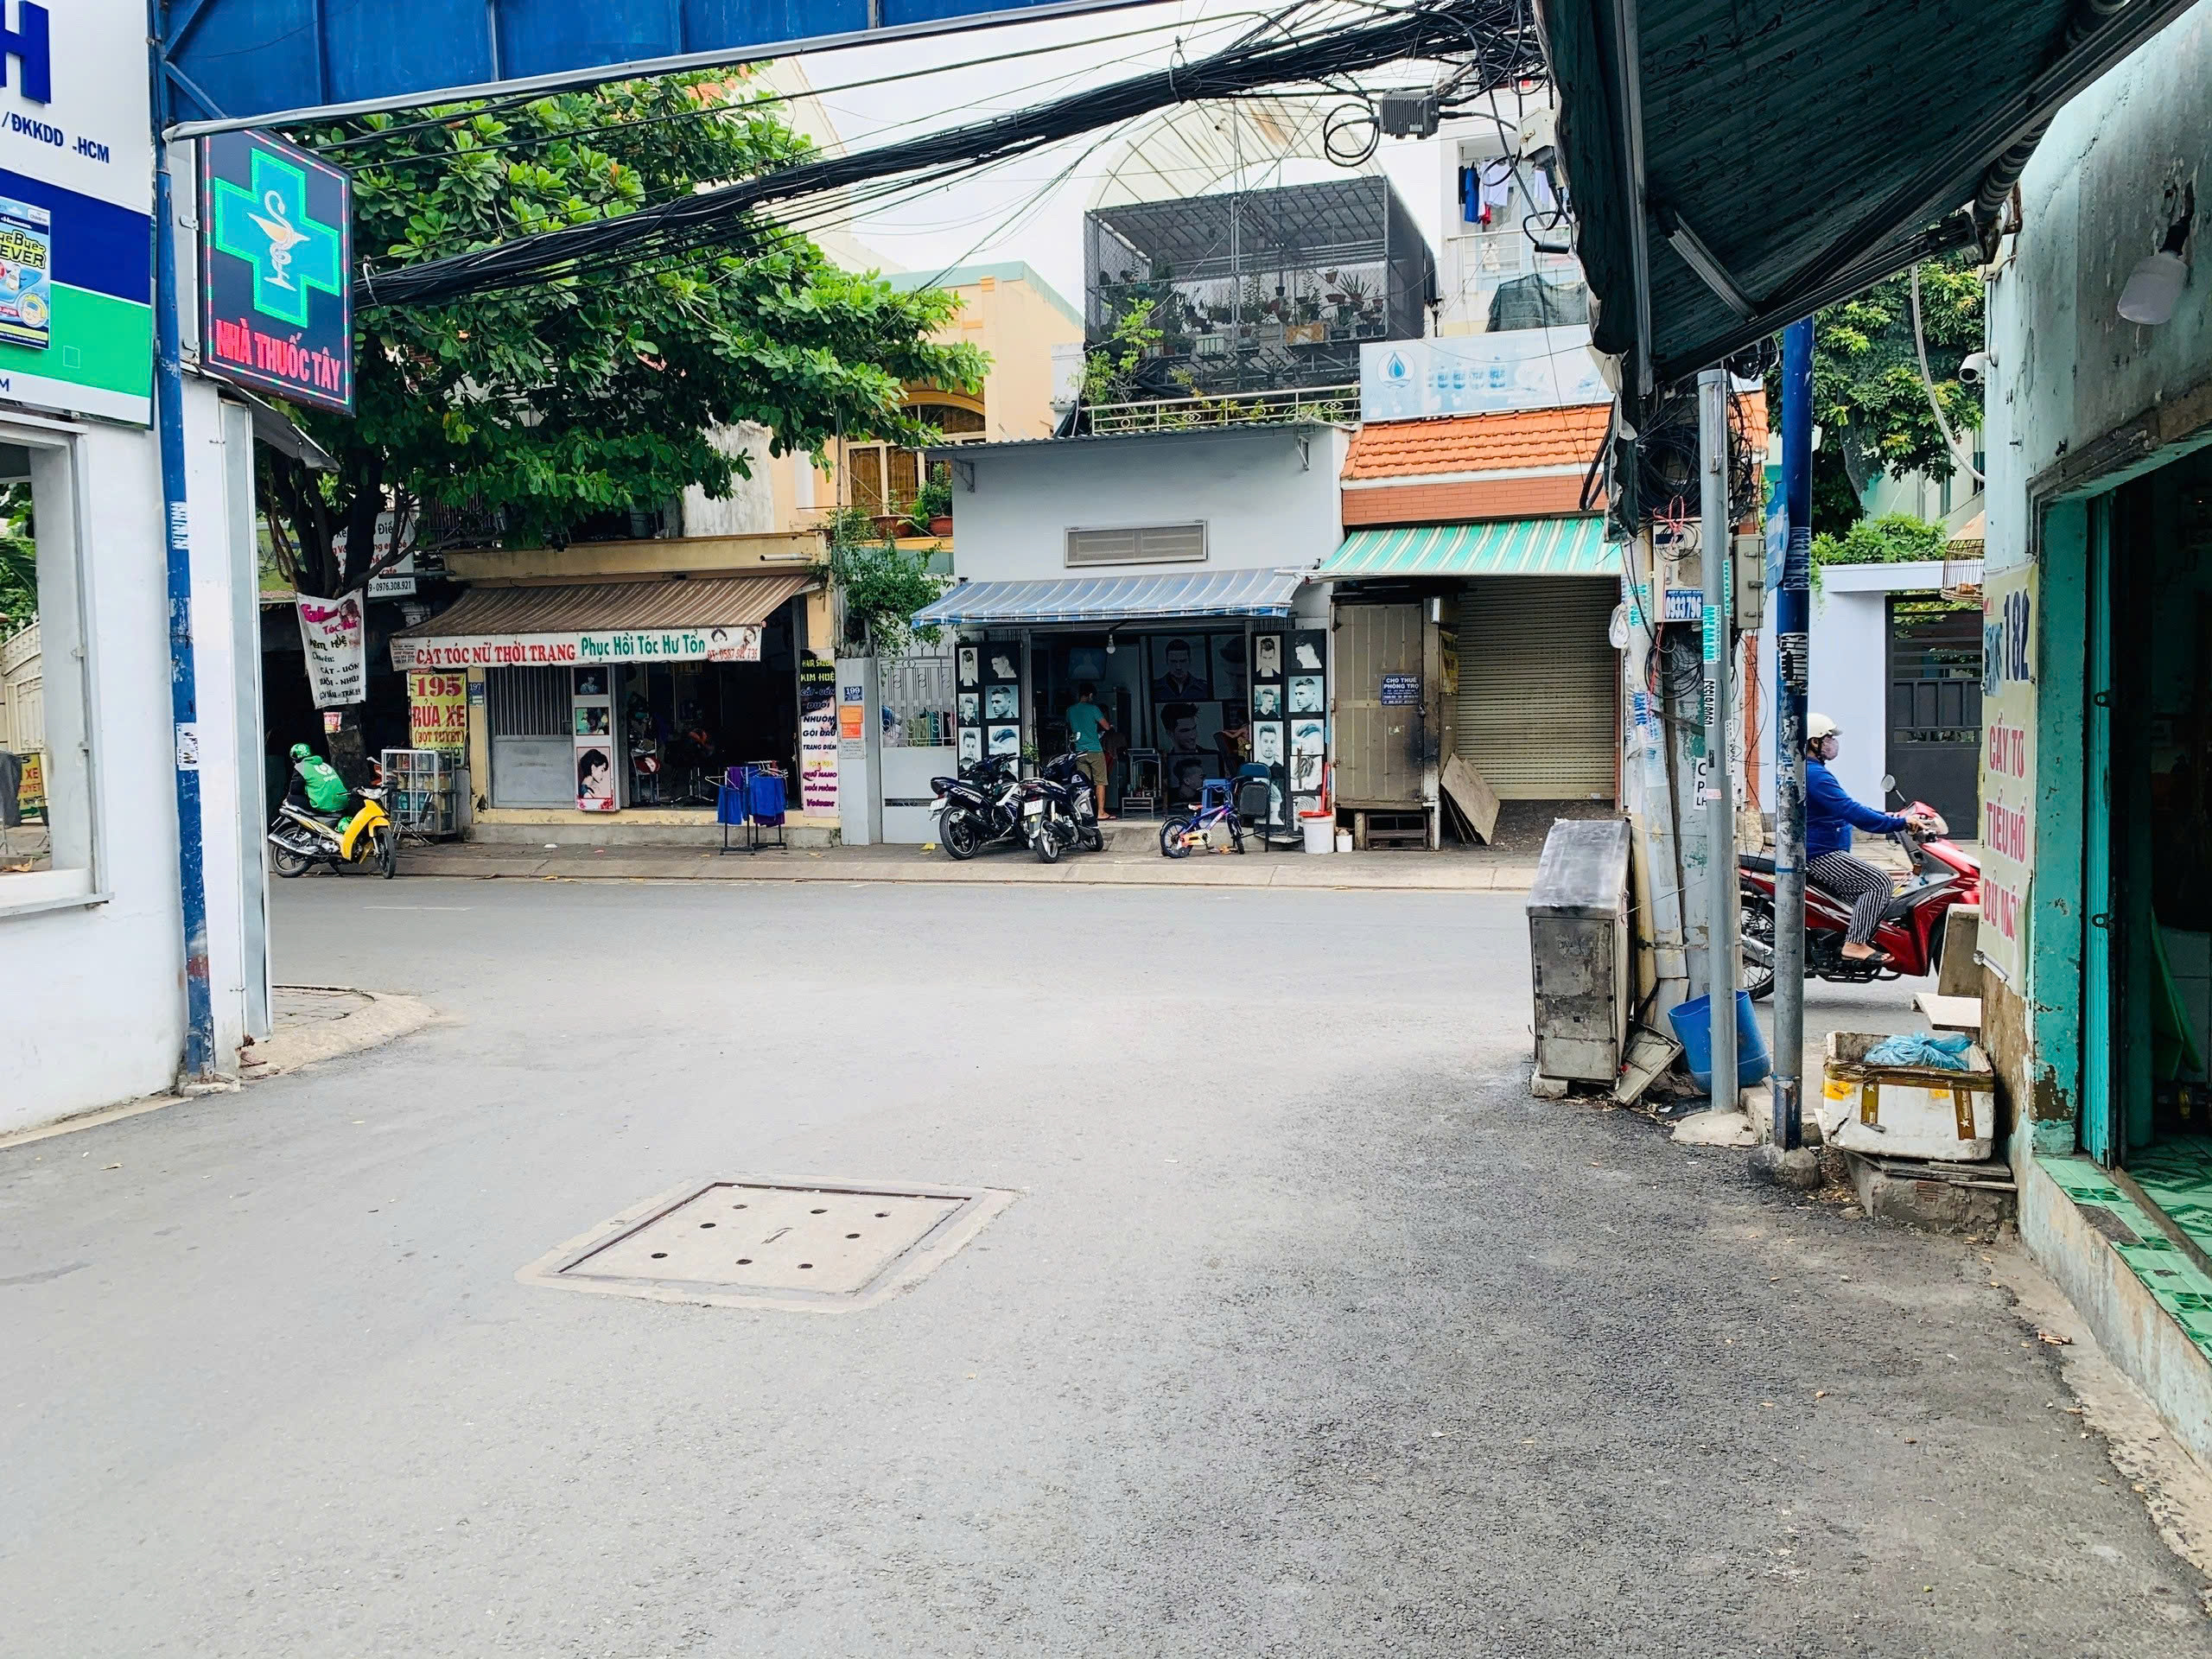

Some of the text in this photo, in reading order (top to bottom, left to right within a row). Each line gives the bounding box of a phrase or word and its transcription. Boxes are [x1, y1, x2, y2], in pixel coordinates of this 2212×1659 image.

[216, 317, 340, 391] NHÀ THUỐC TÂY
[376, 581, 411, 591] 0976.308.921
[2004, 588, 2030, 682] 182
[416, 639, 442, 664] CẮT
[444, 642, 469, 664] TÓC
[473, 641, 492, 663] NỮ
[495, 640, 526, 663] THỜI
[529, 644, 575, 662] TRANG
[582, 637, 610, 663] Phục
[613, 632, 634, 656] Hồi
[638, 636, 658, 654] Tóc
[662, 635, 678, 654] Hư
[683, 630, 705, 653] Tổn
[800, 671, 836, 683] KIM HUỆ
[416, 677, 463, 696] 195
[469, 683, 481, 691] 197
[412, 697, 442, 728] RỬA
[445, 705, 465, 727] XE
[804, 714, 836, 724] NHUỘM
[823, 741, 836, 750] ĐIỂM
